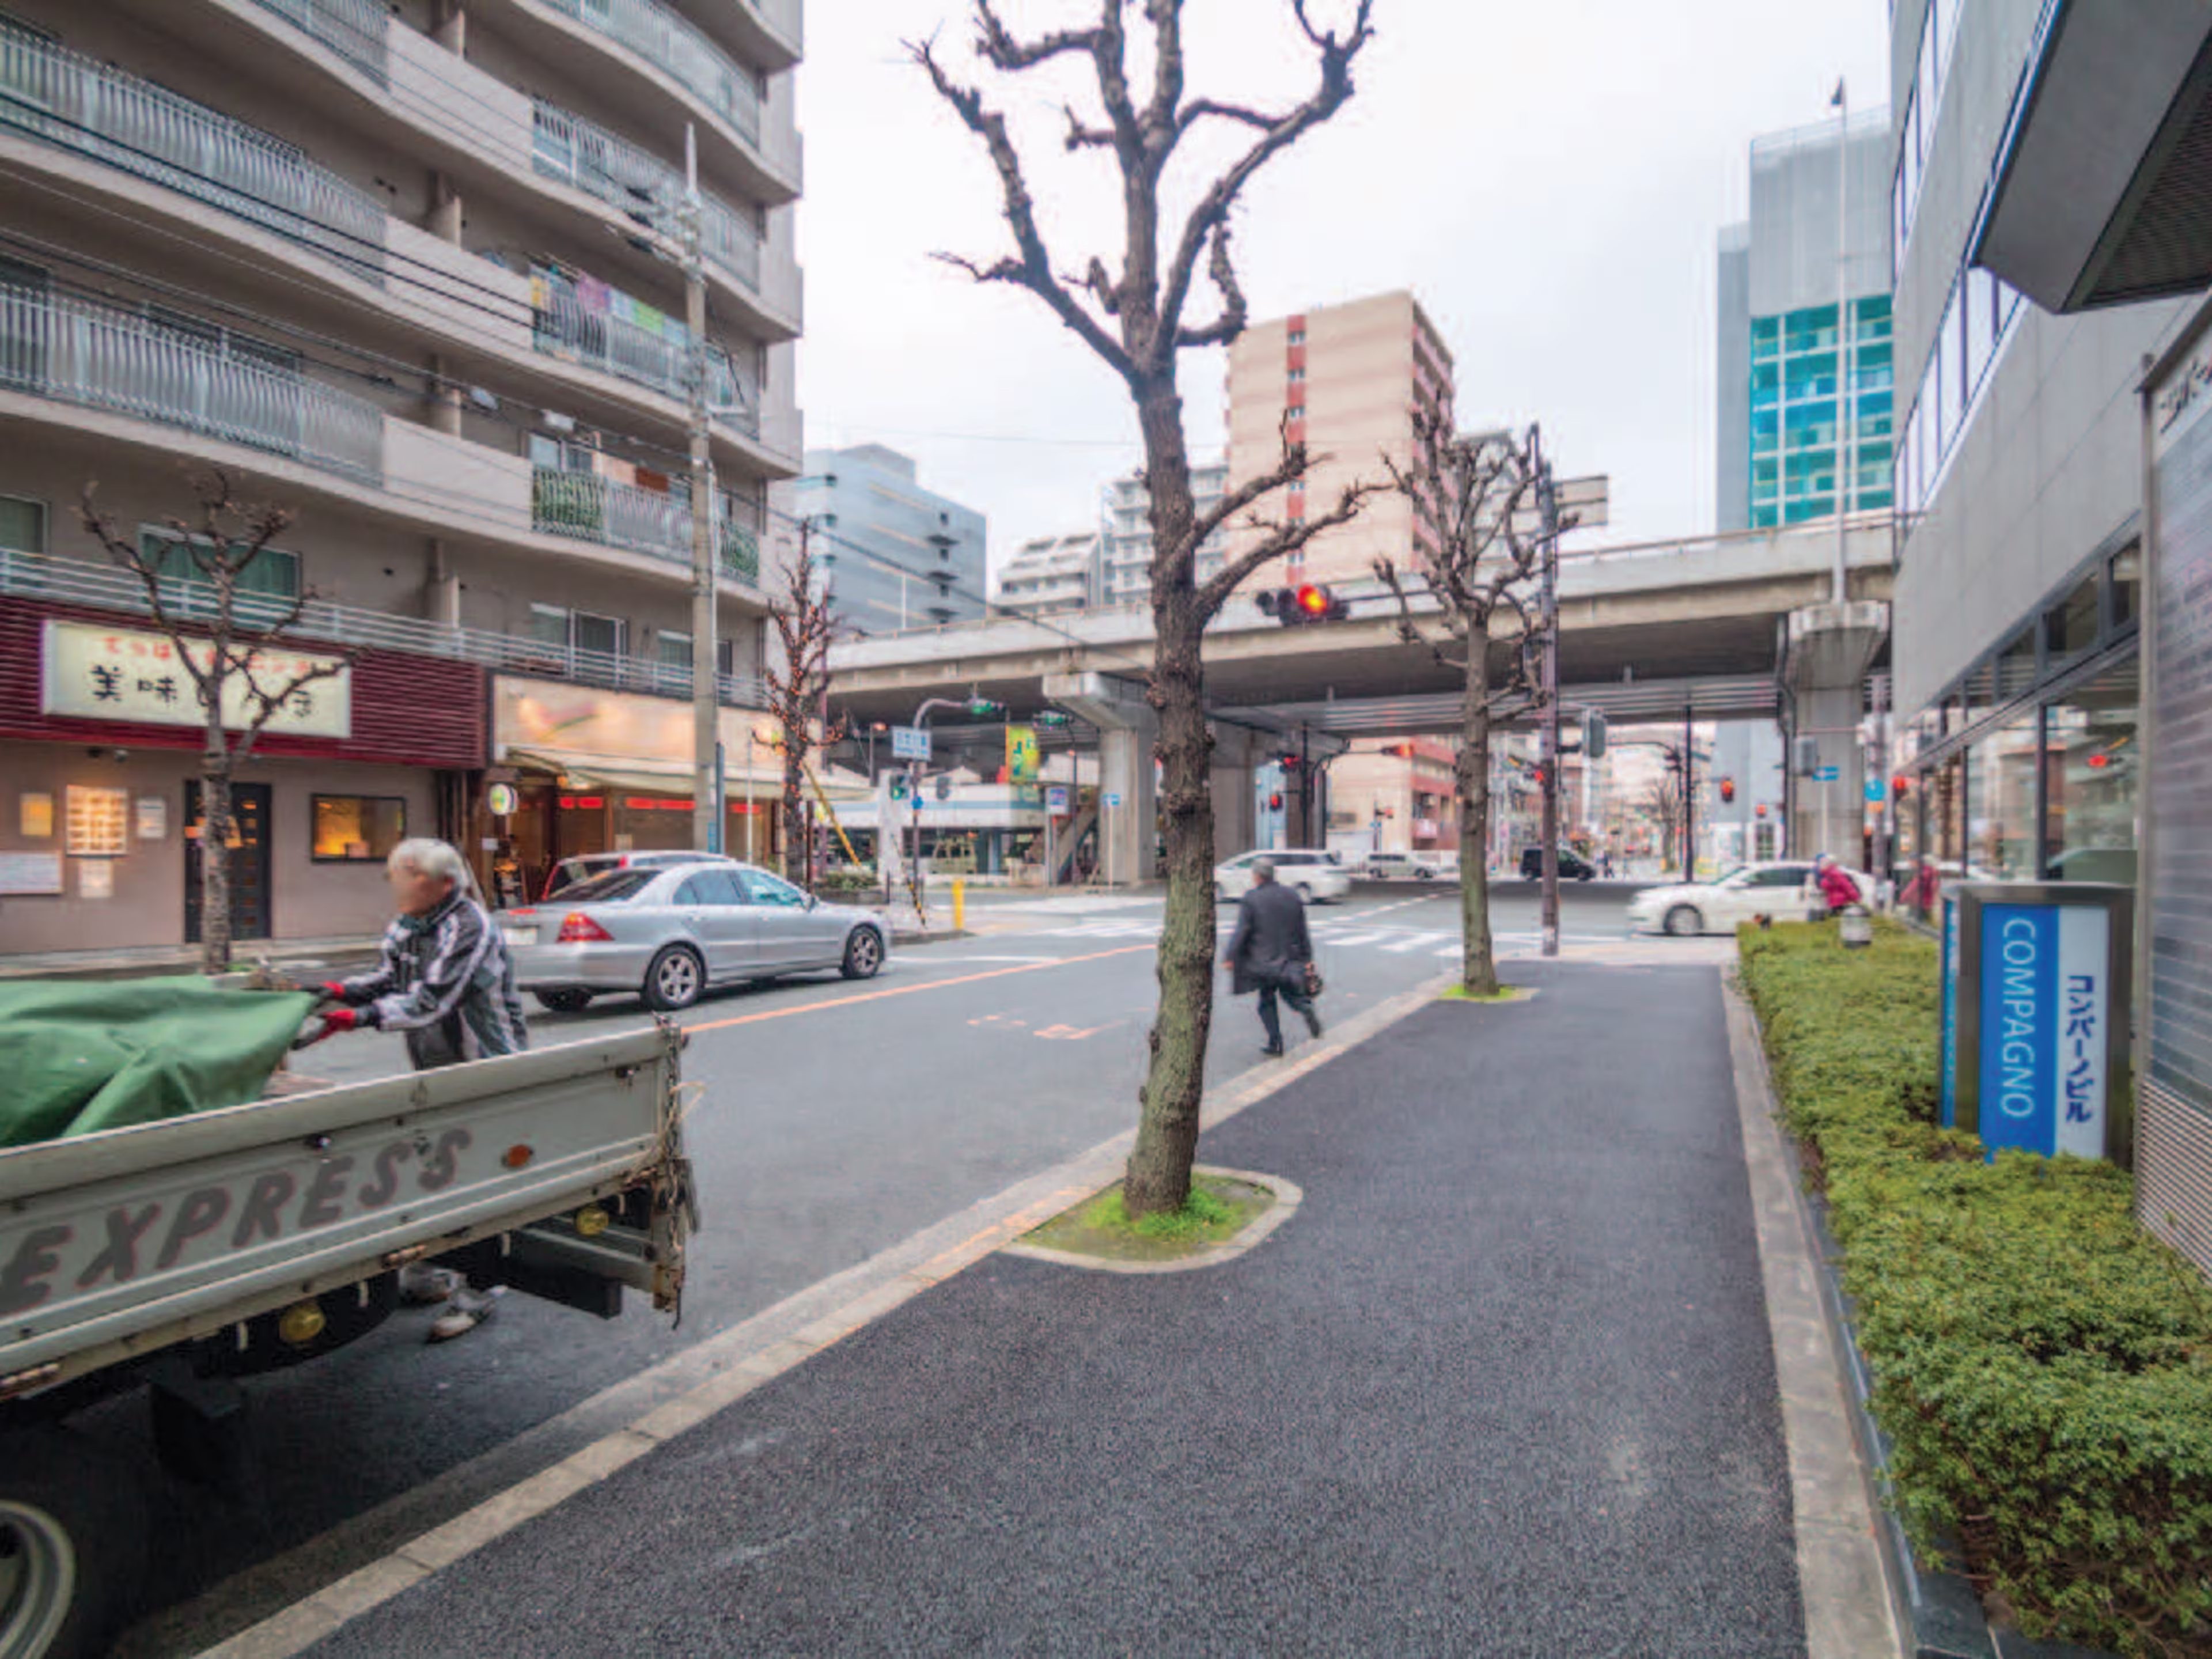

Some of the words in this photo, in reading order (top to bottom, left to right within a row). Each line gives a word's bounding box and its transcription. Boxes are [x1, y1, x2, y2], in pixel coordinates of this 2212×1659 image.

[2001, 918, 2036, 1118] COMPAGNO
[2066, 975, 2096, 1123] コンパーノビル
[0, 1128, 472, 1316] EXPRESS
